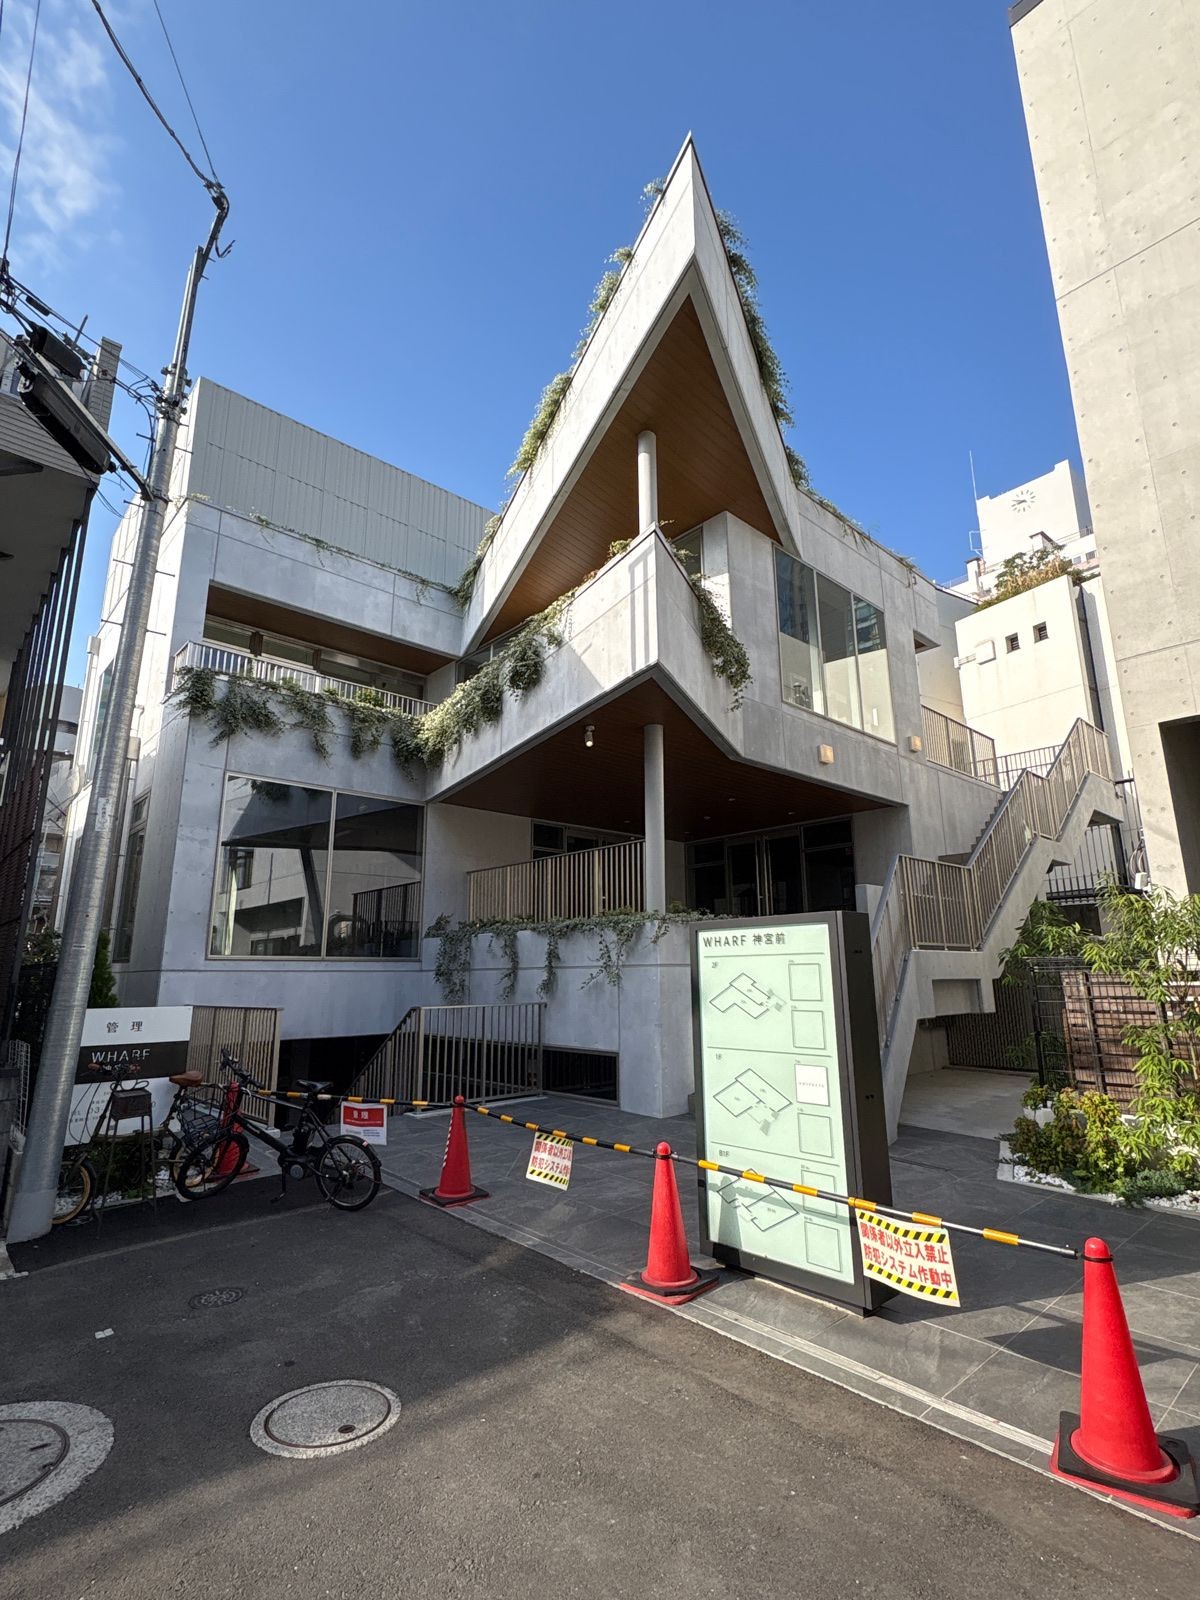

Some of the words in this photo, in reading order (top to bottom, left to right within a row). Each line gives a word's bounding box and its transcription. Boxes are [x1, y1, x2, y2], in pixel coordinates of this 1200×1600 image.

[703, 935, 747, 947] WHARF
[753, 933, 786, 945] 神宮前
[106, 1021, 143, 1033] 管理
[91, 1048, 151, 1063] WHARF
[860, 1221, 950, 1265] 関係者以外立入禁止
[863, 1243, 953, 1289] 防犯システム作動中
